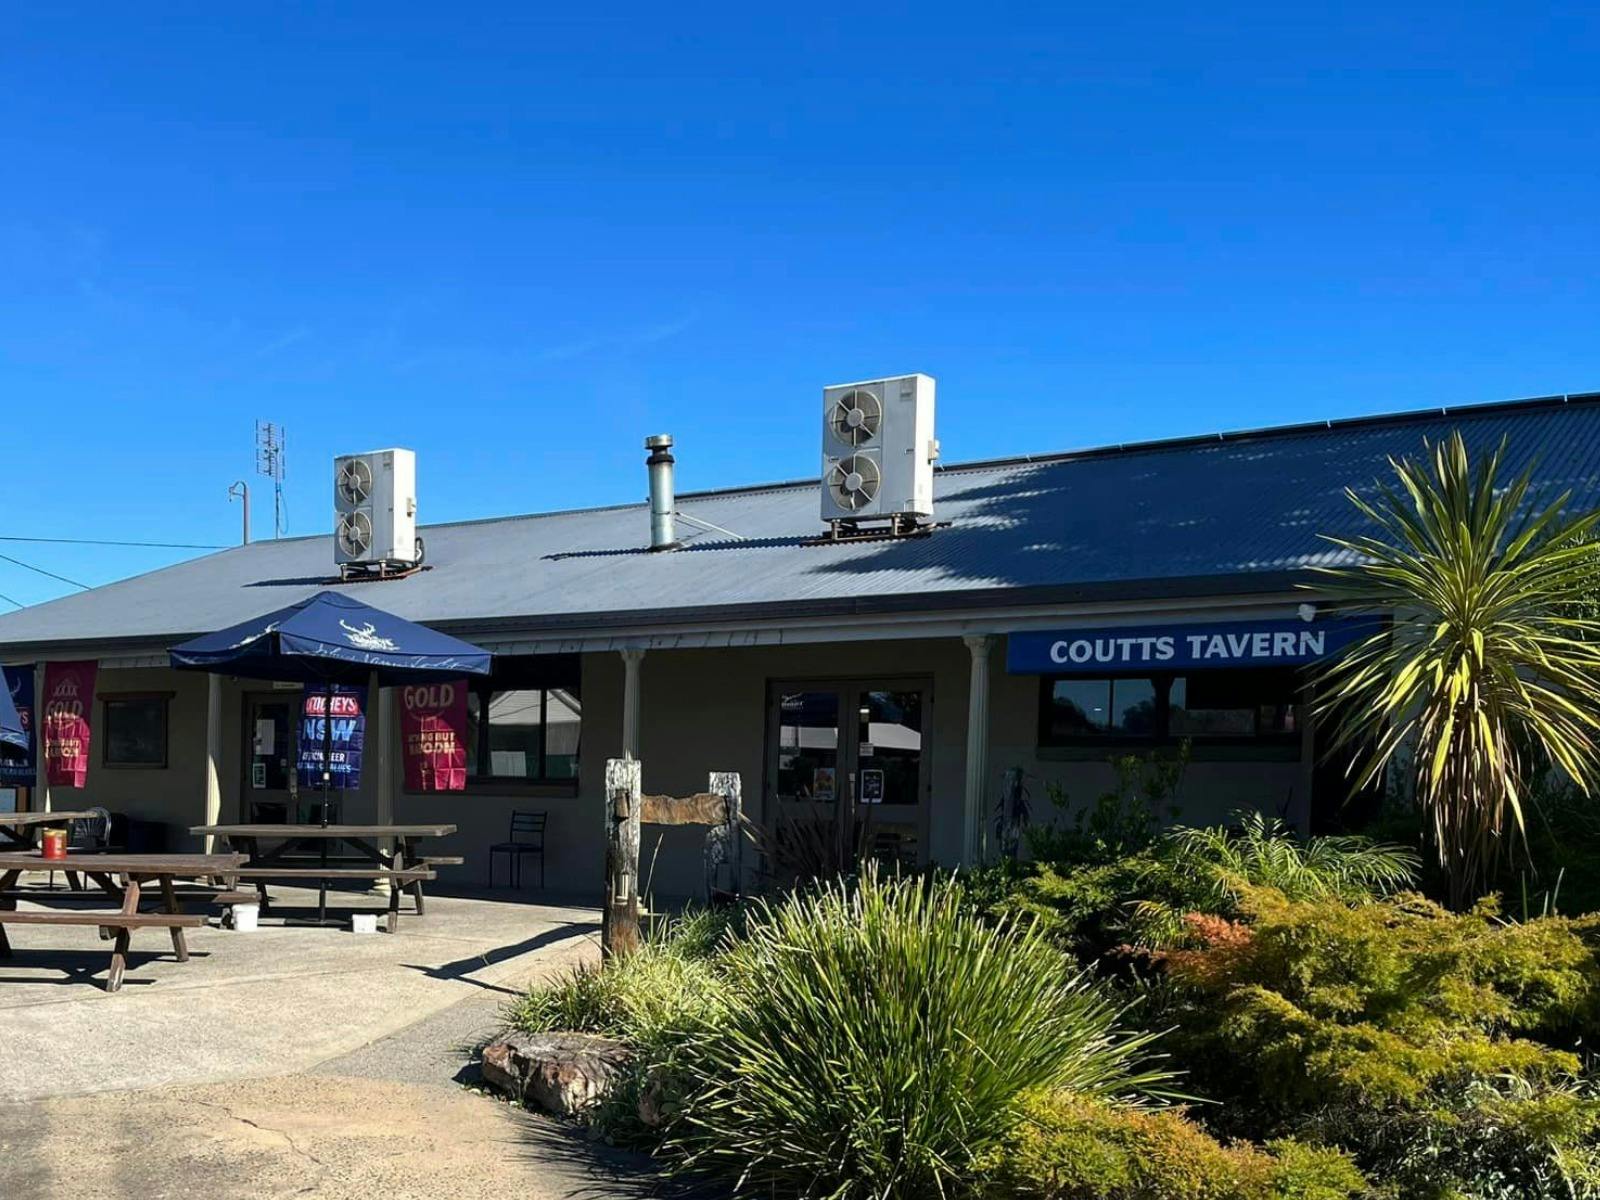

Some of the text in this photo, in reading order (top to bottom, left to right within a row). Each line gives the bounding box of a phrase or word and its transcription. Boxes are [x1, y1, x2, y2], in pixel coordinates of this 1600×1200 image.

[1050, 630, 1326, 664] COUTTS TAVERN
[404, 684, 455, 710] GOLD
[302, 718, 357, 741] NSW
[329, 752, 345, 762] EER
